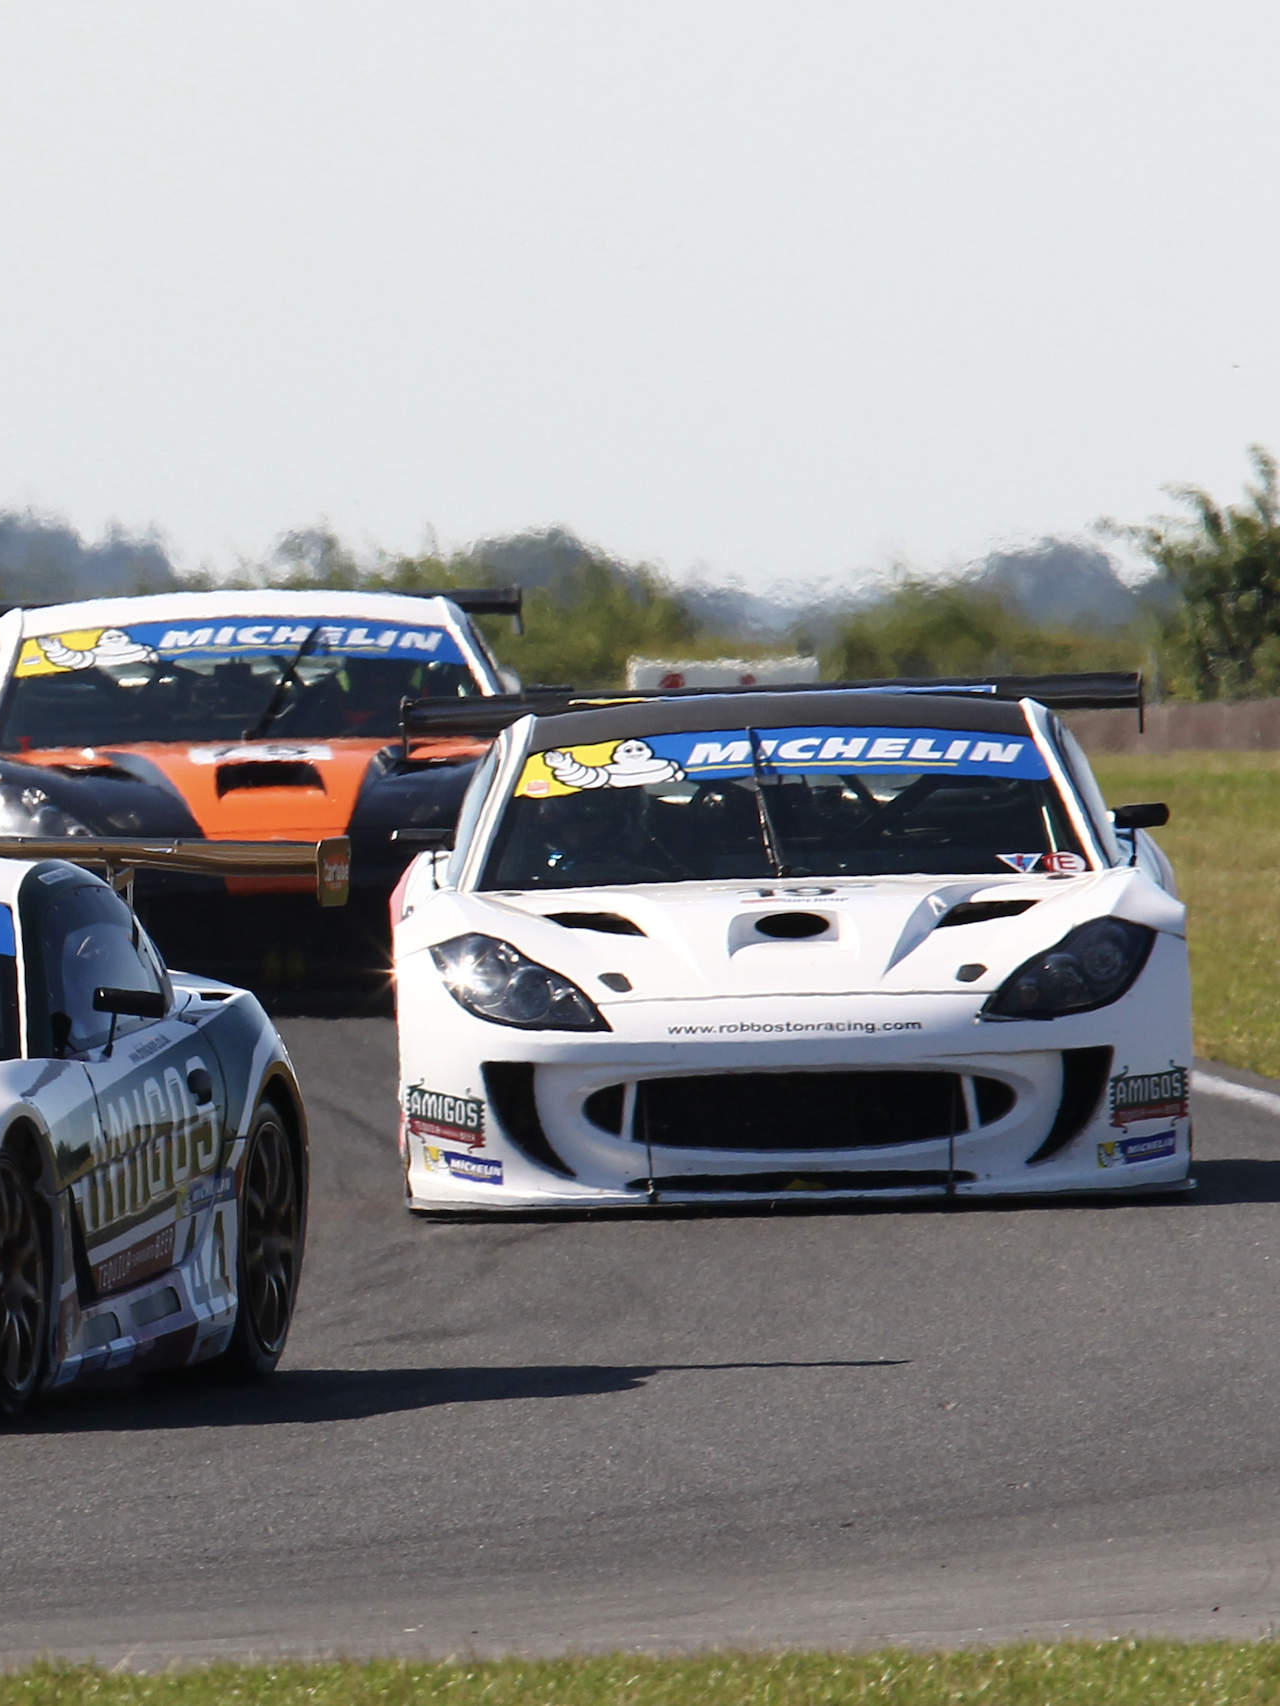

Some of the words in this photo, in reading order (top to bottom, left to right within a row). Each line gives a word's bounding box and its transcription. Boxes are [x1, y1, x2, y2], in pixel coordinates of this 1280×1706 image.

[157, 624, 443, 652] MICHELIN
[667, 1019, 923, 1035] www.robbostonracing.com
[1115, 1072, 1181, 1104] AMIGOS
[409, 1090, 479, 1128] AMIGOS
[81, 1055, 218, 1237] AMIGOS
[449, 1158, 503, 1176] MICHELIN
